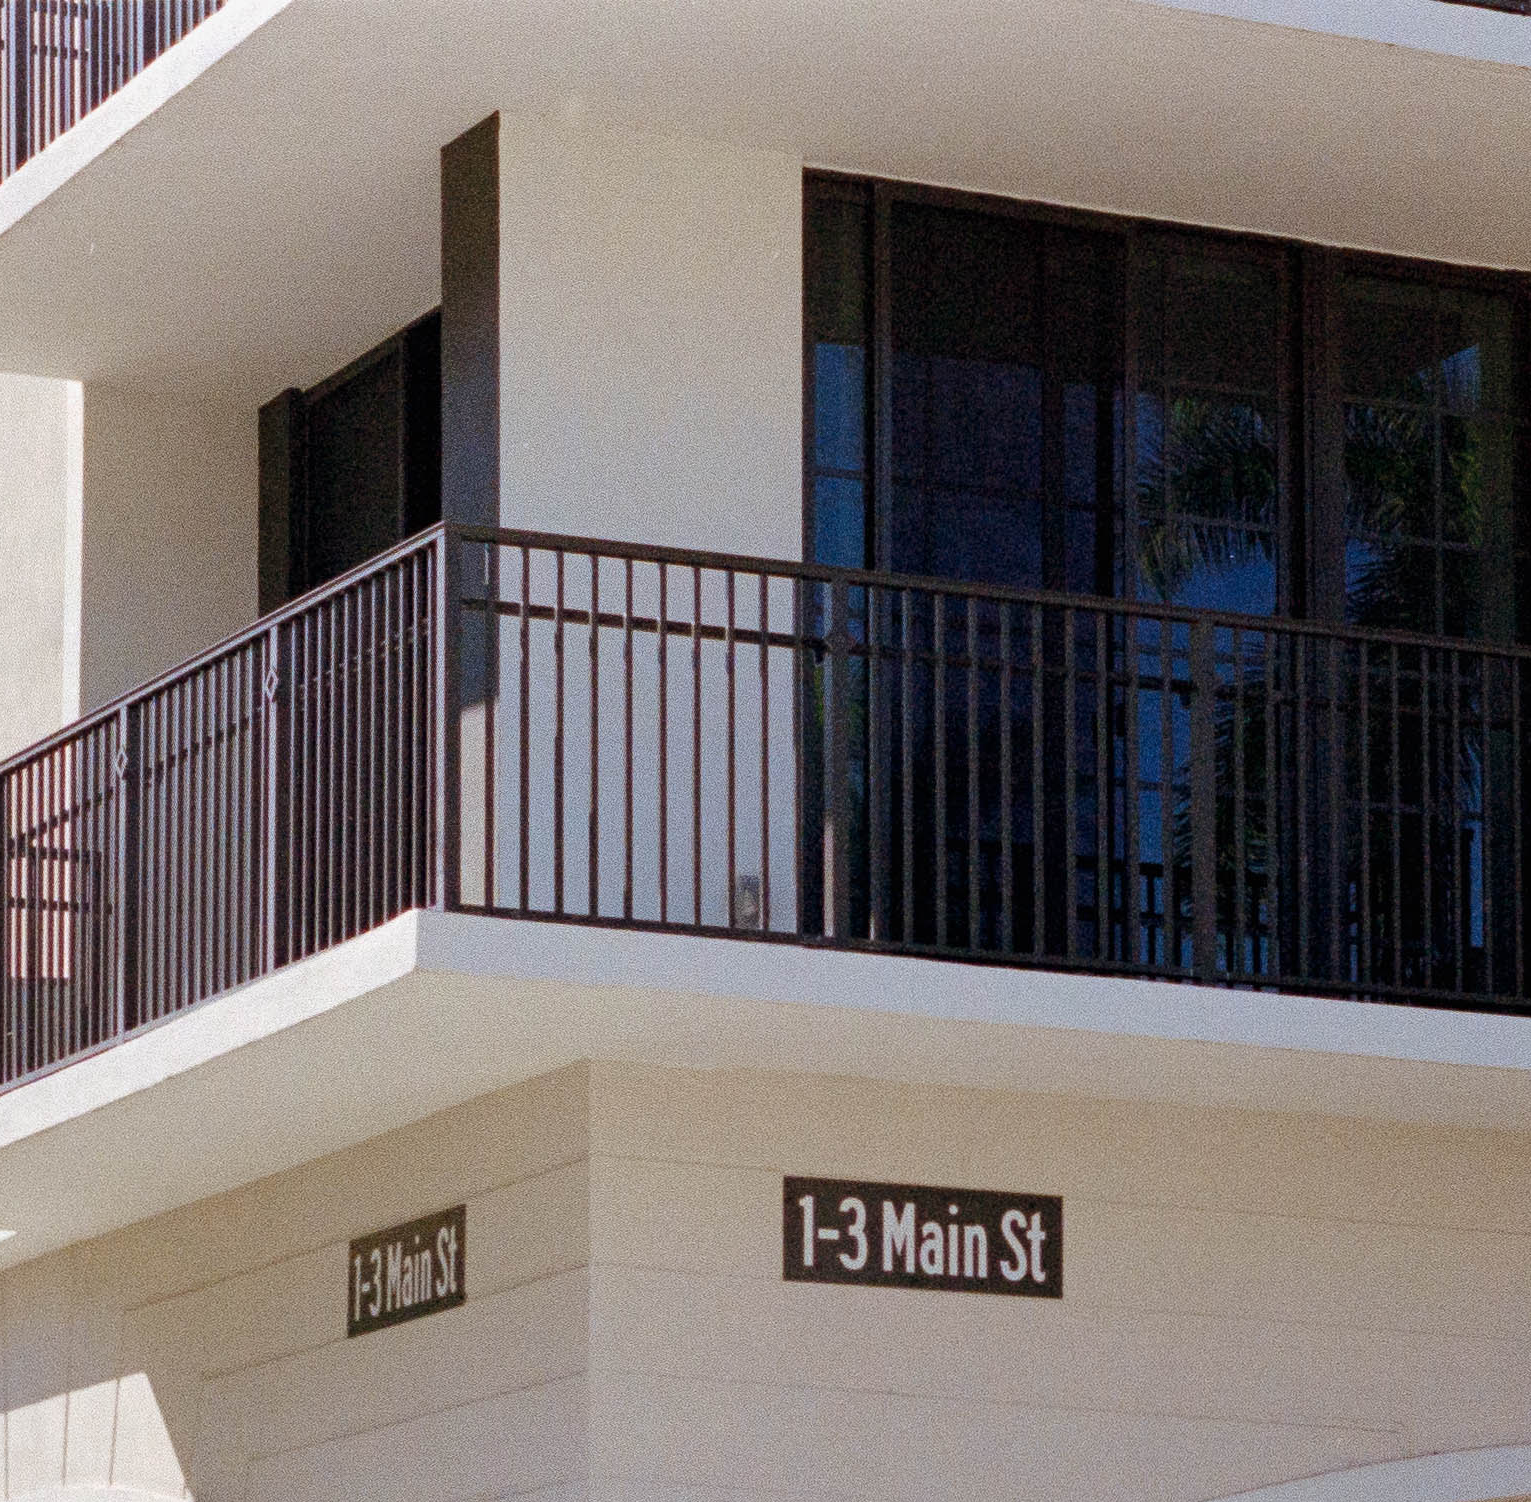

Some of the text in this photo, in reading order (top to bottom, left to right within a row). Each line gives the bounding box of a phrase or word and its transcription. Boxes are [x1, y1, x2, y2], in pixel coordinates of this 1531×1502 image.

[354, 1225, 458, 1321] 1-3 Main St
[799, 1194, 1047, 1284] 1-3 Main St
